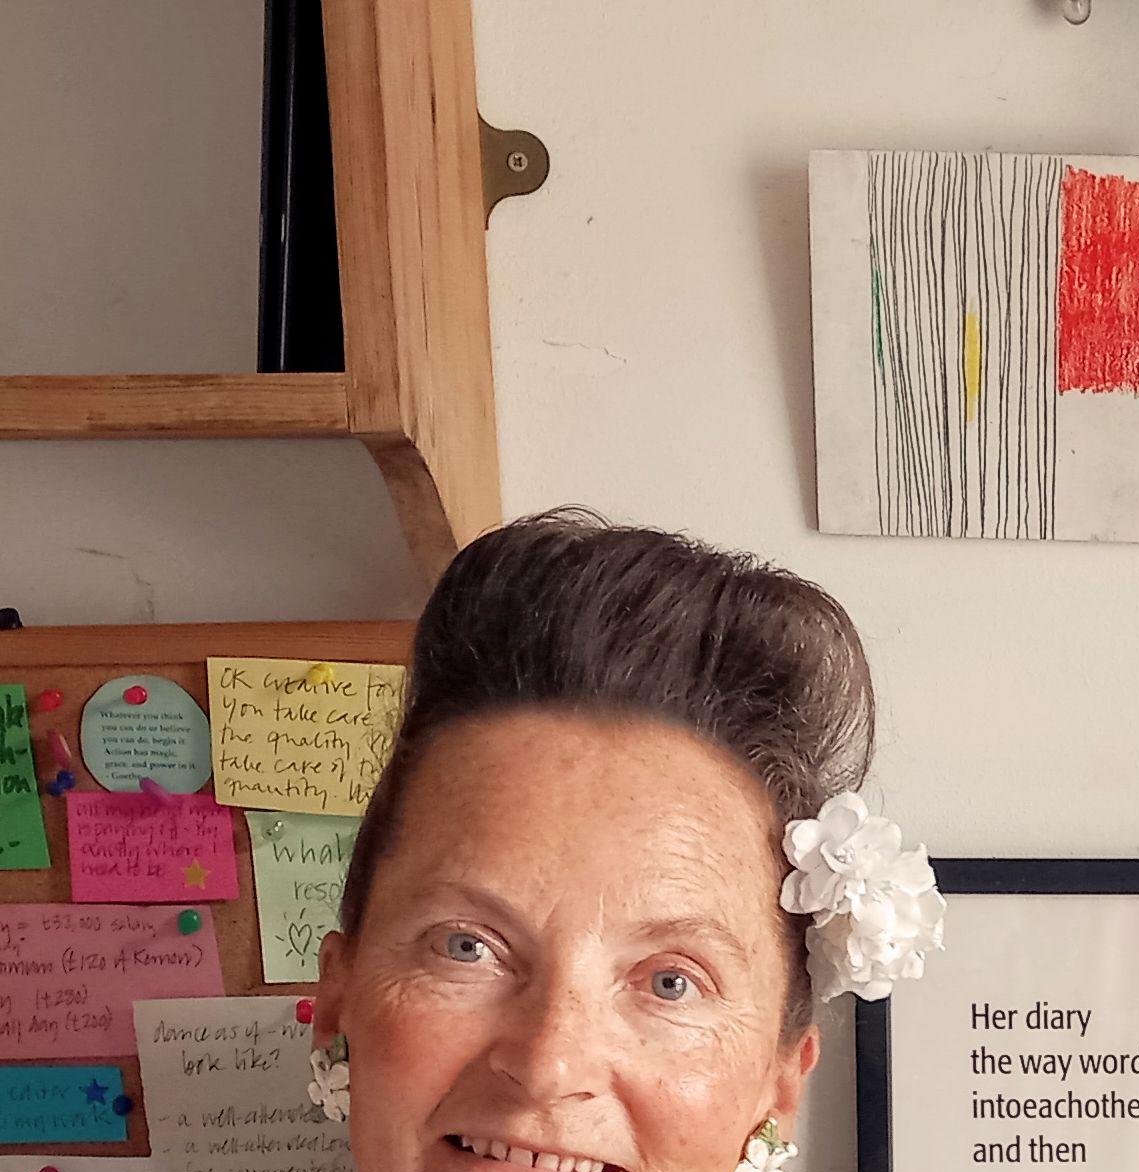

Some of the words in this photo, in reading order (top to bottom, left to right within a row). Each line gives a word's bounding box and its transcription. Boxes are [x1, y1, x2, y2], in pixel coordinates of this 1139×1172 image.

[972, 1003, 1017, 1029] Her
[1026, 1002, 1091, 1037] diary
[971, 1046, 1011, 1074] the
[1019, 1055, 1072, 1081] way
[974, 1135, 1020, 1162] and
[1029, 1135, 1086, 1162] then
